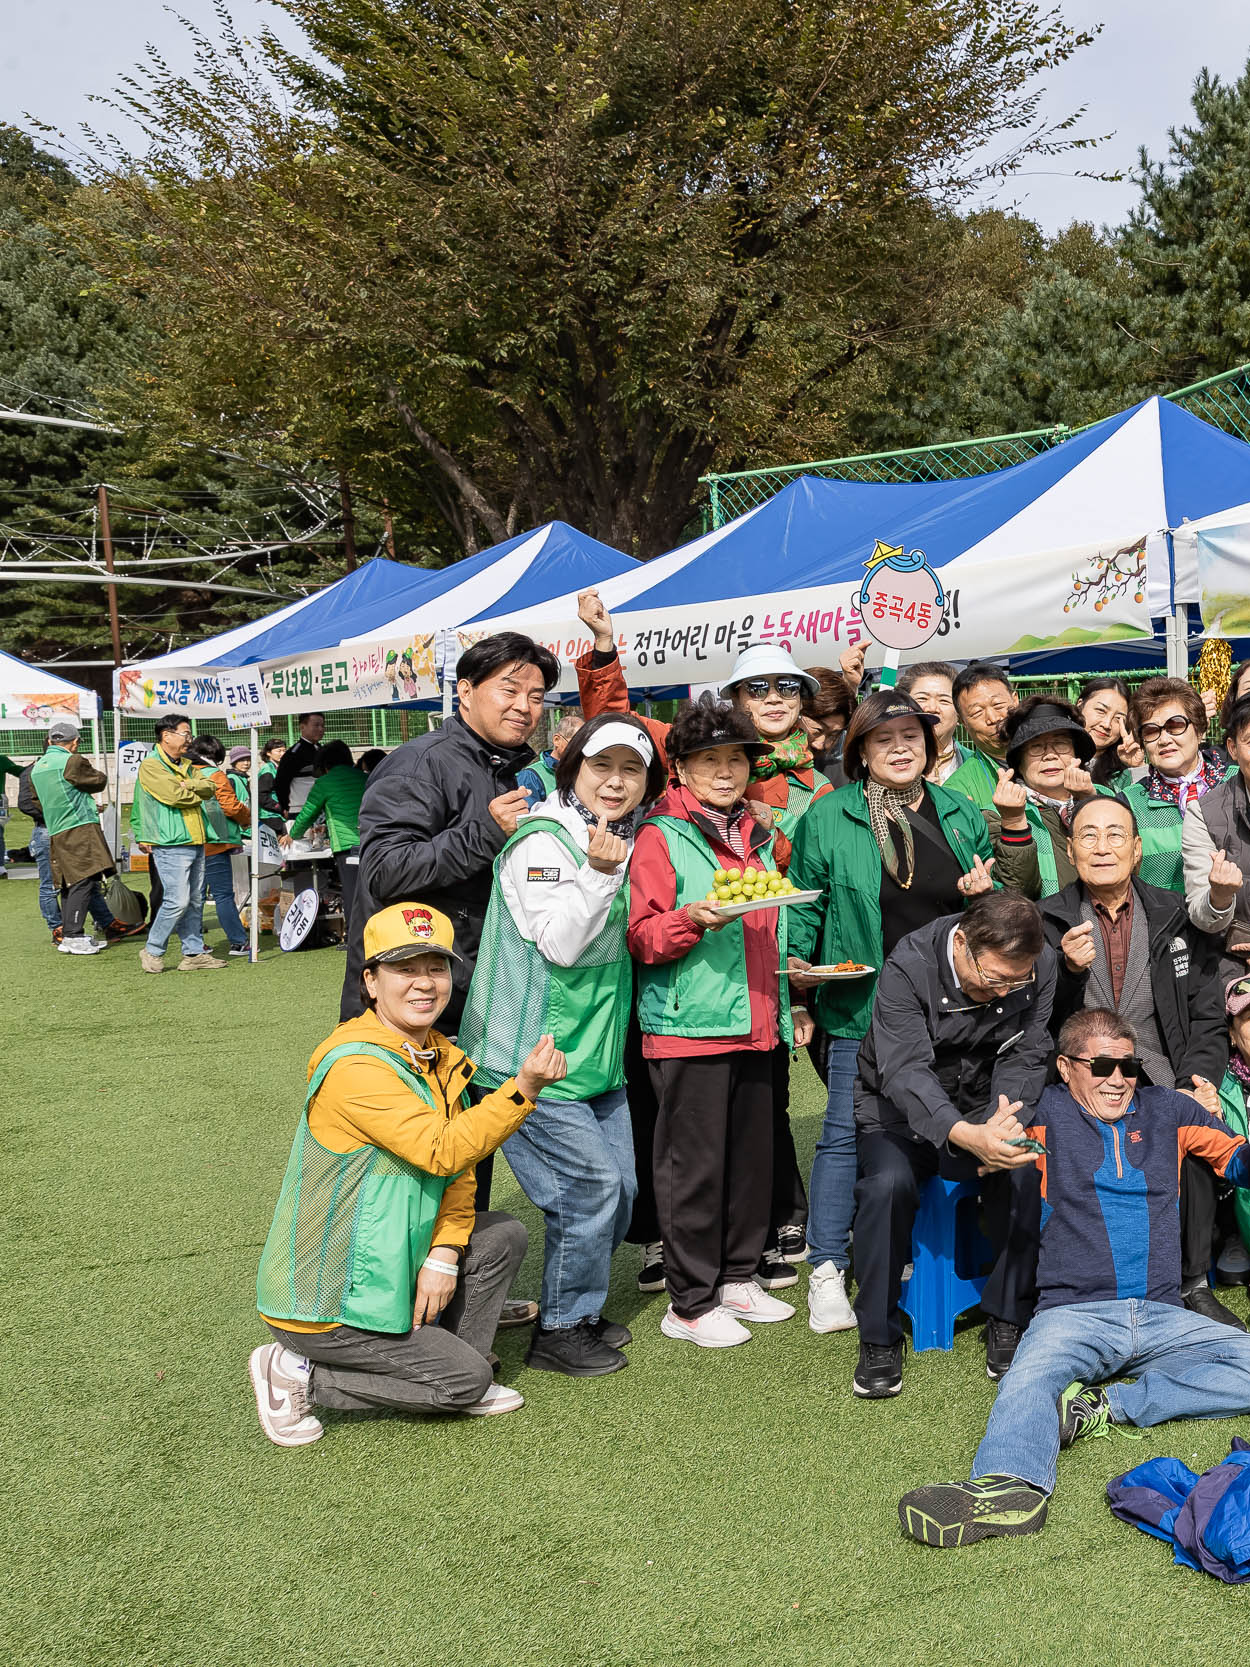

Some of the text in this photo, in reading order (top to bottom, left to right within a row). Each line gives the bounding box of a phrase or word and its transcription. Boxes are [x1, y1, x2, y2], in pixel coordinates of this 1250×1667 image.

[872, 591, 932, 630] 중곡4동
[634, 623, 709, 667] 정감어린
[714, 614, 755, 655] 마을
[156, 679, 191, 706] 군자동
[226, 682, 260, 708] 군자동
